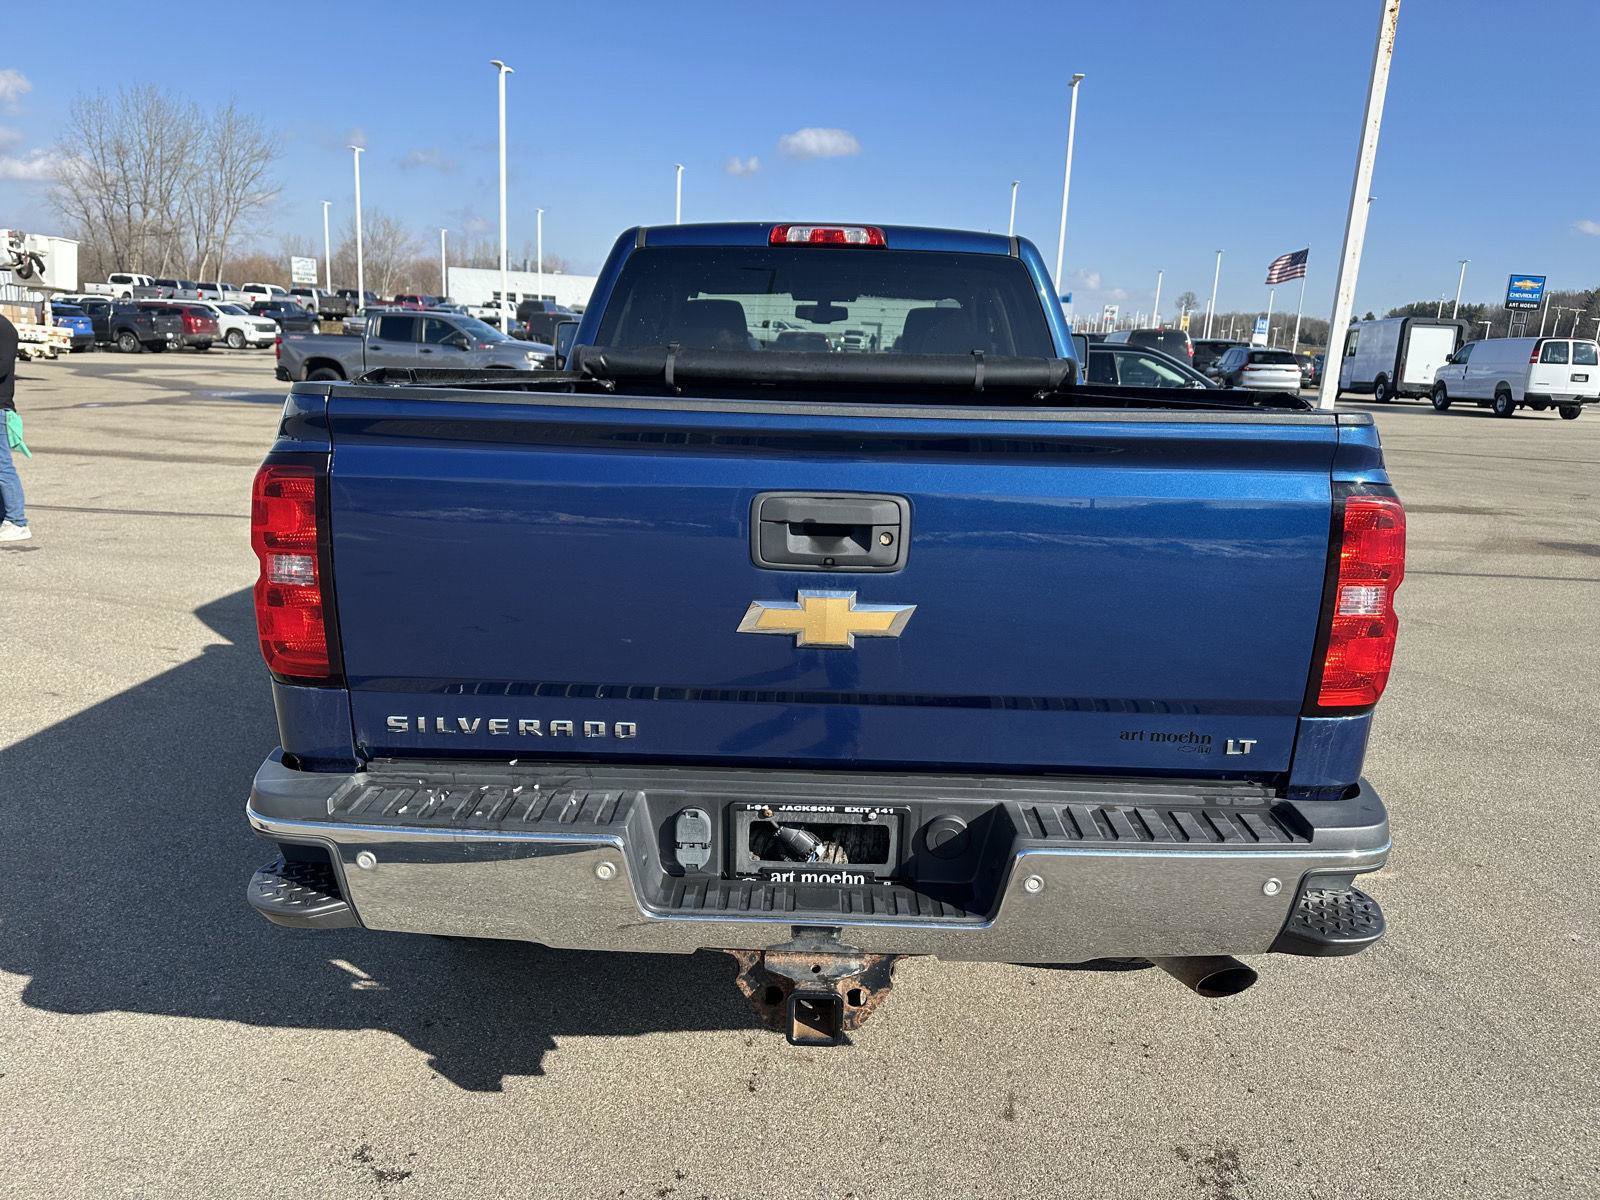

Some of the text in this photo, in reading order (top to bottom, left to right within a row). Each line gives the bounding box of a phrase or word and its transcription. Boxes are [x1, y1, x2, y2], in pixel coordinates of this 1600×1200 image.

[386, 715, 637, 739] SILVERADO
[1119, 729, 1212, 745] art moehn
[1225, 739, 1257, 755] LT
[778, 805, 835, 813] JACKSON
[844, 806, 872, 814] EXIT
[770, 870, 865, 885] art moehn
